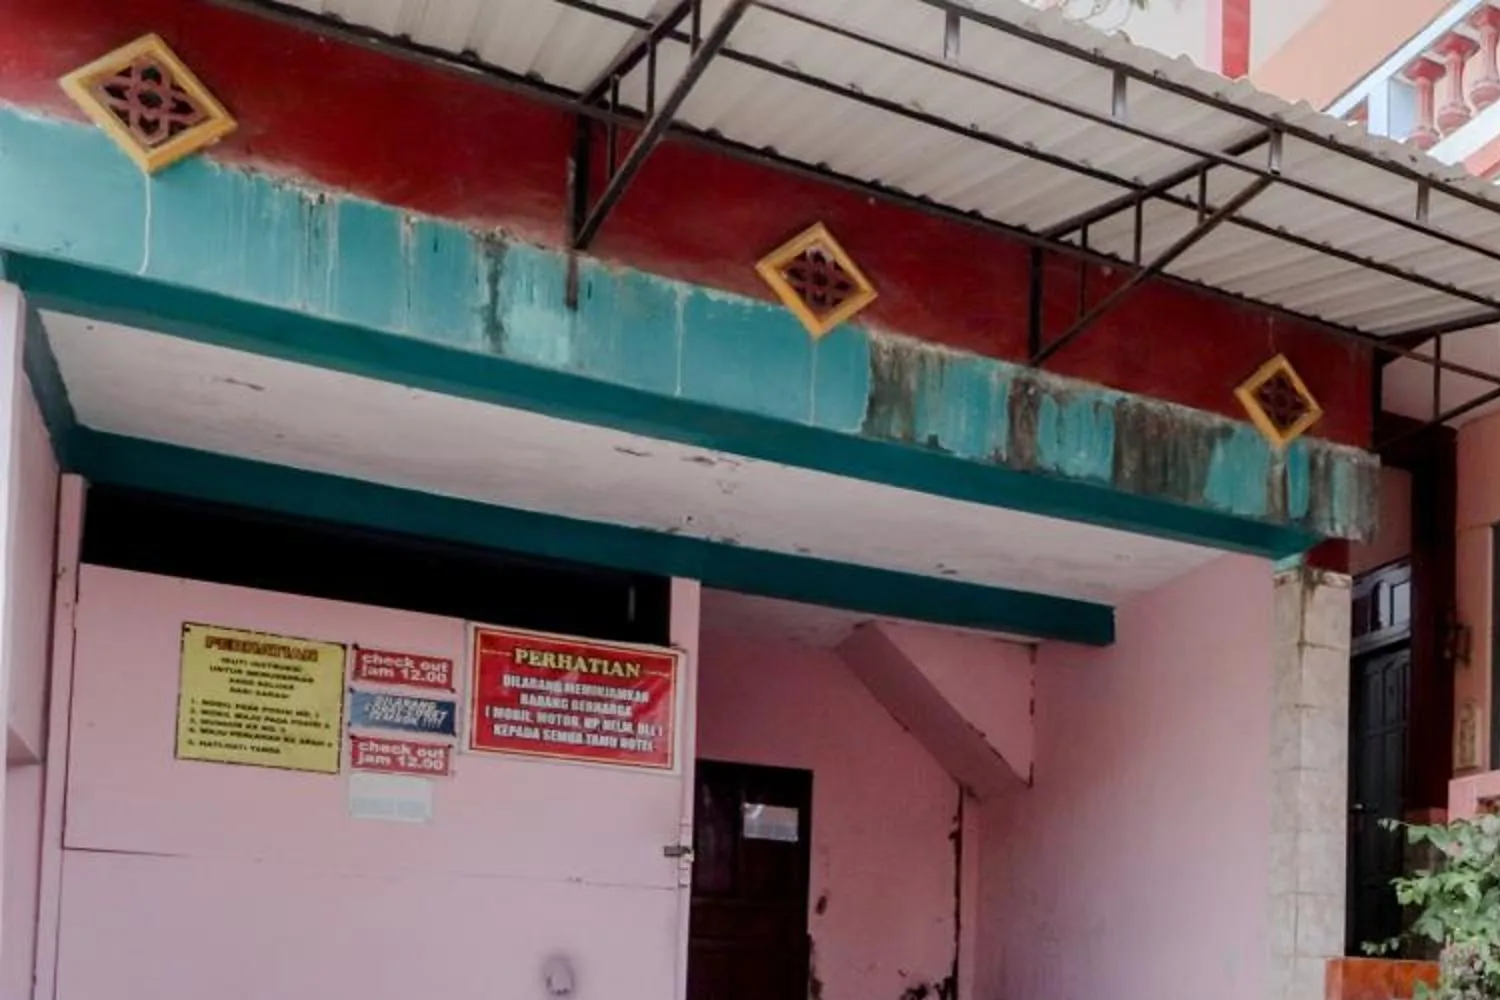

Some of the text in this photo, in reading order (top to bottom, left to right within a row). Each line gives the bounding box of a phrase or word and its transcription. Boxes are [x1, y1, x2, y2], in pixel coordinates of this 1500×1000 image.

[361, 652, 449, 674] check out
[515, 648, 641, 677] PERHATIAN
[401, 667, 449, 684] 12.00
[503, 673, 563, 694] DILARANG
[519, 693, 633, 718] BARANG BERHARGA
[494, 723, 541, 741] KEPADA
[542, 729, 584, 745] SEMUA
[585, 733, 619, 749] TAMU
[358, 740, 445, 759] check out
[398, 754, 445, 771] 12.00
